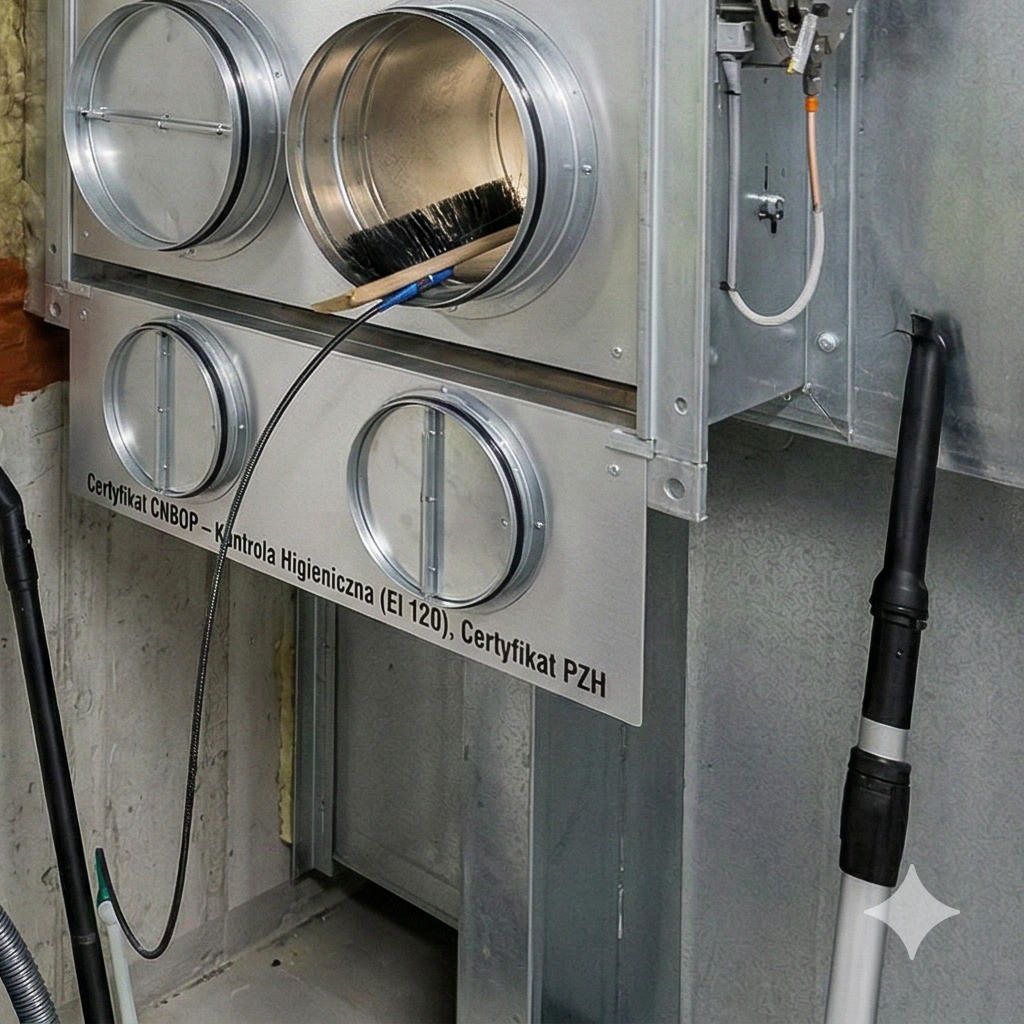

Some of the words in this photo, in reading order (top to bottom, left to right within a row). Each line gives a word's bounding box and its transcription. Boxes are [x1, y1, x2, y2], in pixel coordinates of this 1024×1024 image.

[87, 472, 147, 514] Certyfikat
[151, 499, 199, 532] CNBOP
[281, 547, 374, 606] Higieniczna
[380, 586, 404, 617] (EI
[408, 598, 454, 641] 120),
[461, 619, 557, 678] Certyfikat
[563, 658, 607, 699] PZH
